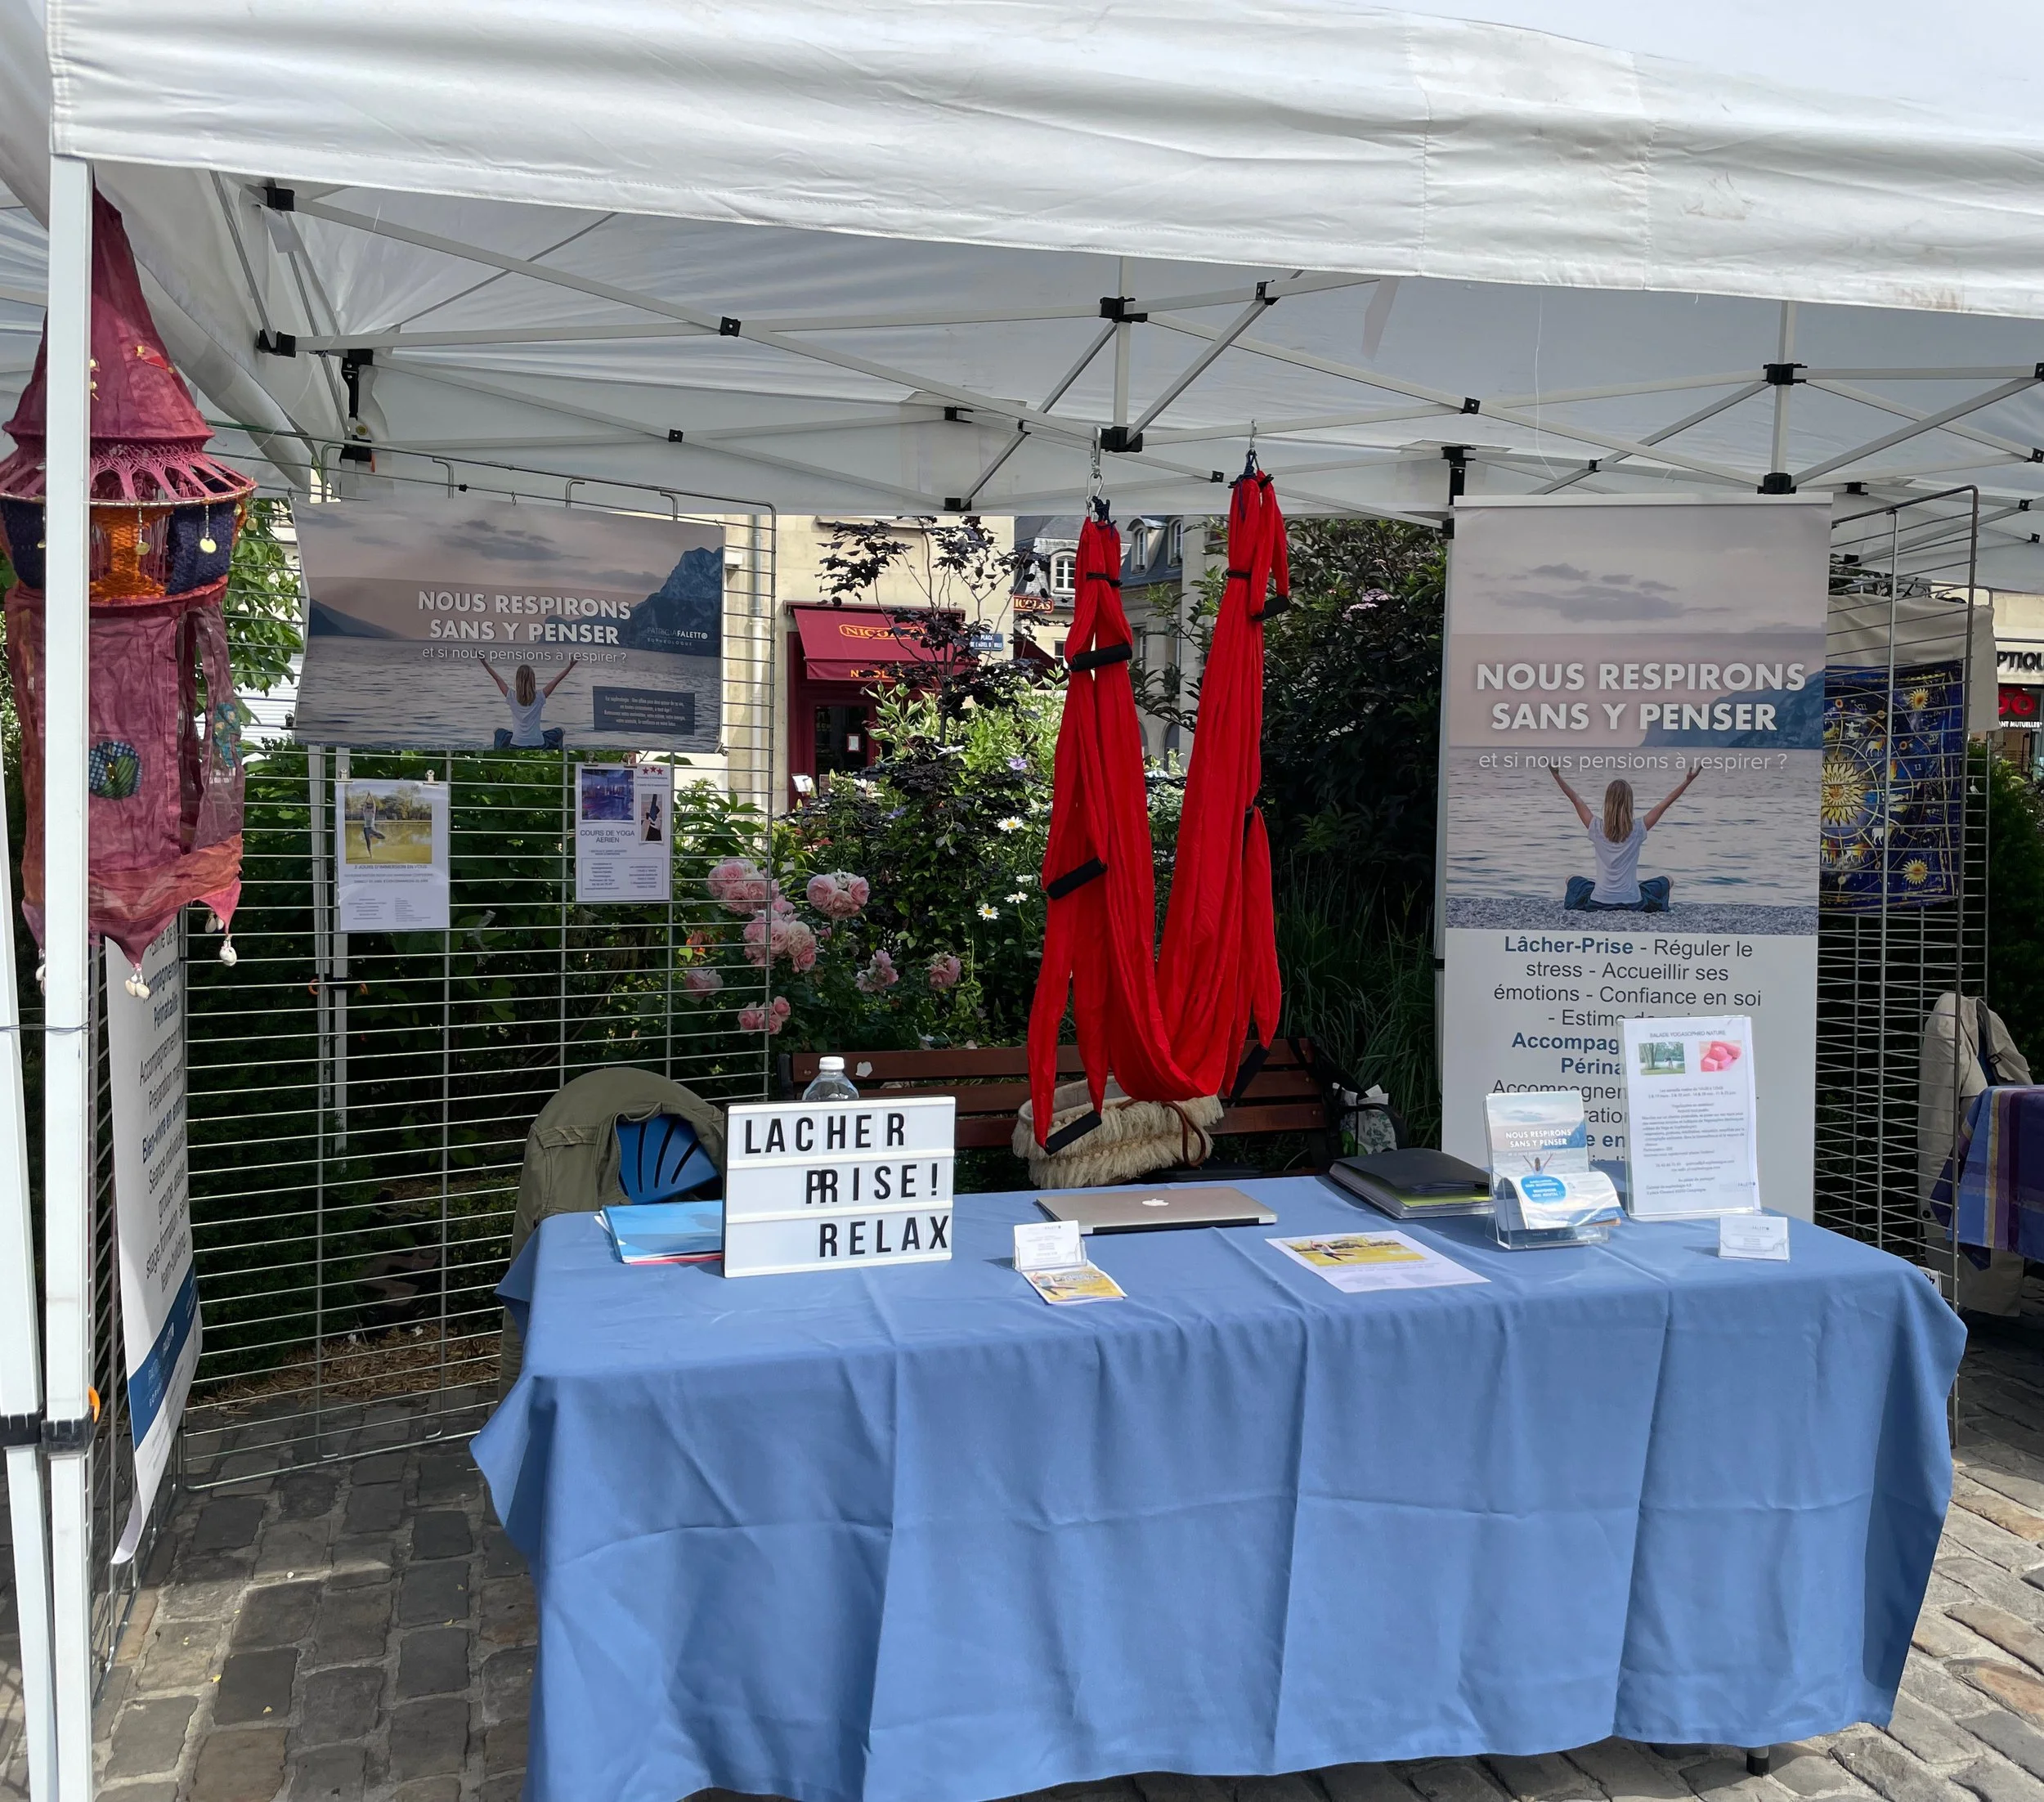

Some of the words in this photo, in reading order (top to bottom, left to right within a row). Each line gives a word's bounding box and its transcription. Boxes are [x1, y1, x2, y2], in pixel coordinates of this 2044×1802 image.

[419, 591, 486, 612] NOUS
[495, 595, 630, 620] RESPIRONS
[1015, 598, 1051, 610] ICOLAS
[430, 620, 494, 640] SANS
[502, 622, 520, 641] Y
[529, 624, 620, 644] PENSER
[423, 648, 434, 658] et
[438, 648, 448, 658] si
[452, 649, 485, 660] nous
[491, 649, 552, 661] pensions
[556, 649, 563, 661] à
[568, 652, 617, 663] respirer
[621, 652, 626, 663] ?
[1997, 652, 2044, 669] PTIQU
[1477, 663, 1585, 691] NOUS
[1598, 663, 1805, 691] RESPIRONS
[1490, 703, 1589, 730] SANS
[1602, 703, 1627, 730] Y
[1639, 703, 1777, 730] PENSER
[1479, 754, 1497, 768] et
[1504, 752, 1517, 768] si
[1525, 755, 1572, 769] nous
[1580, 752, 1668, 772] pensions
[1675, 751, 1687, 769] à
[1693, 754, 1770, 773] respirer
[1778, 753, 1787, 769] ?
[1504, 936, 1634, 954] Lâcher-Prise
[1654, 939, 1730, 960] Réguler
[1737, 940, 1753, 957] le
[1526, 962, 1583, 978] stress
[1602, 962, 1690, 980] Accueillir
[1695, 968, 1728, 981] ses
[1494, 984, 1580, 1001] émotions
[1599, 986, 1697, 1005] Confiance
[1703, 992, 1727, 1006] en
[1733, 990, 1761, 1006] soi
[1512, 1032, 1619, 1055] Accompag
[745, 1113, 905, 1154] LACHER
[1531, 1129, 1571, 1137] RESPIRONS
[1540, 1138, 1567, 1146] PENSER
[819, 1215, 949, 1257] RELAX
